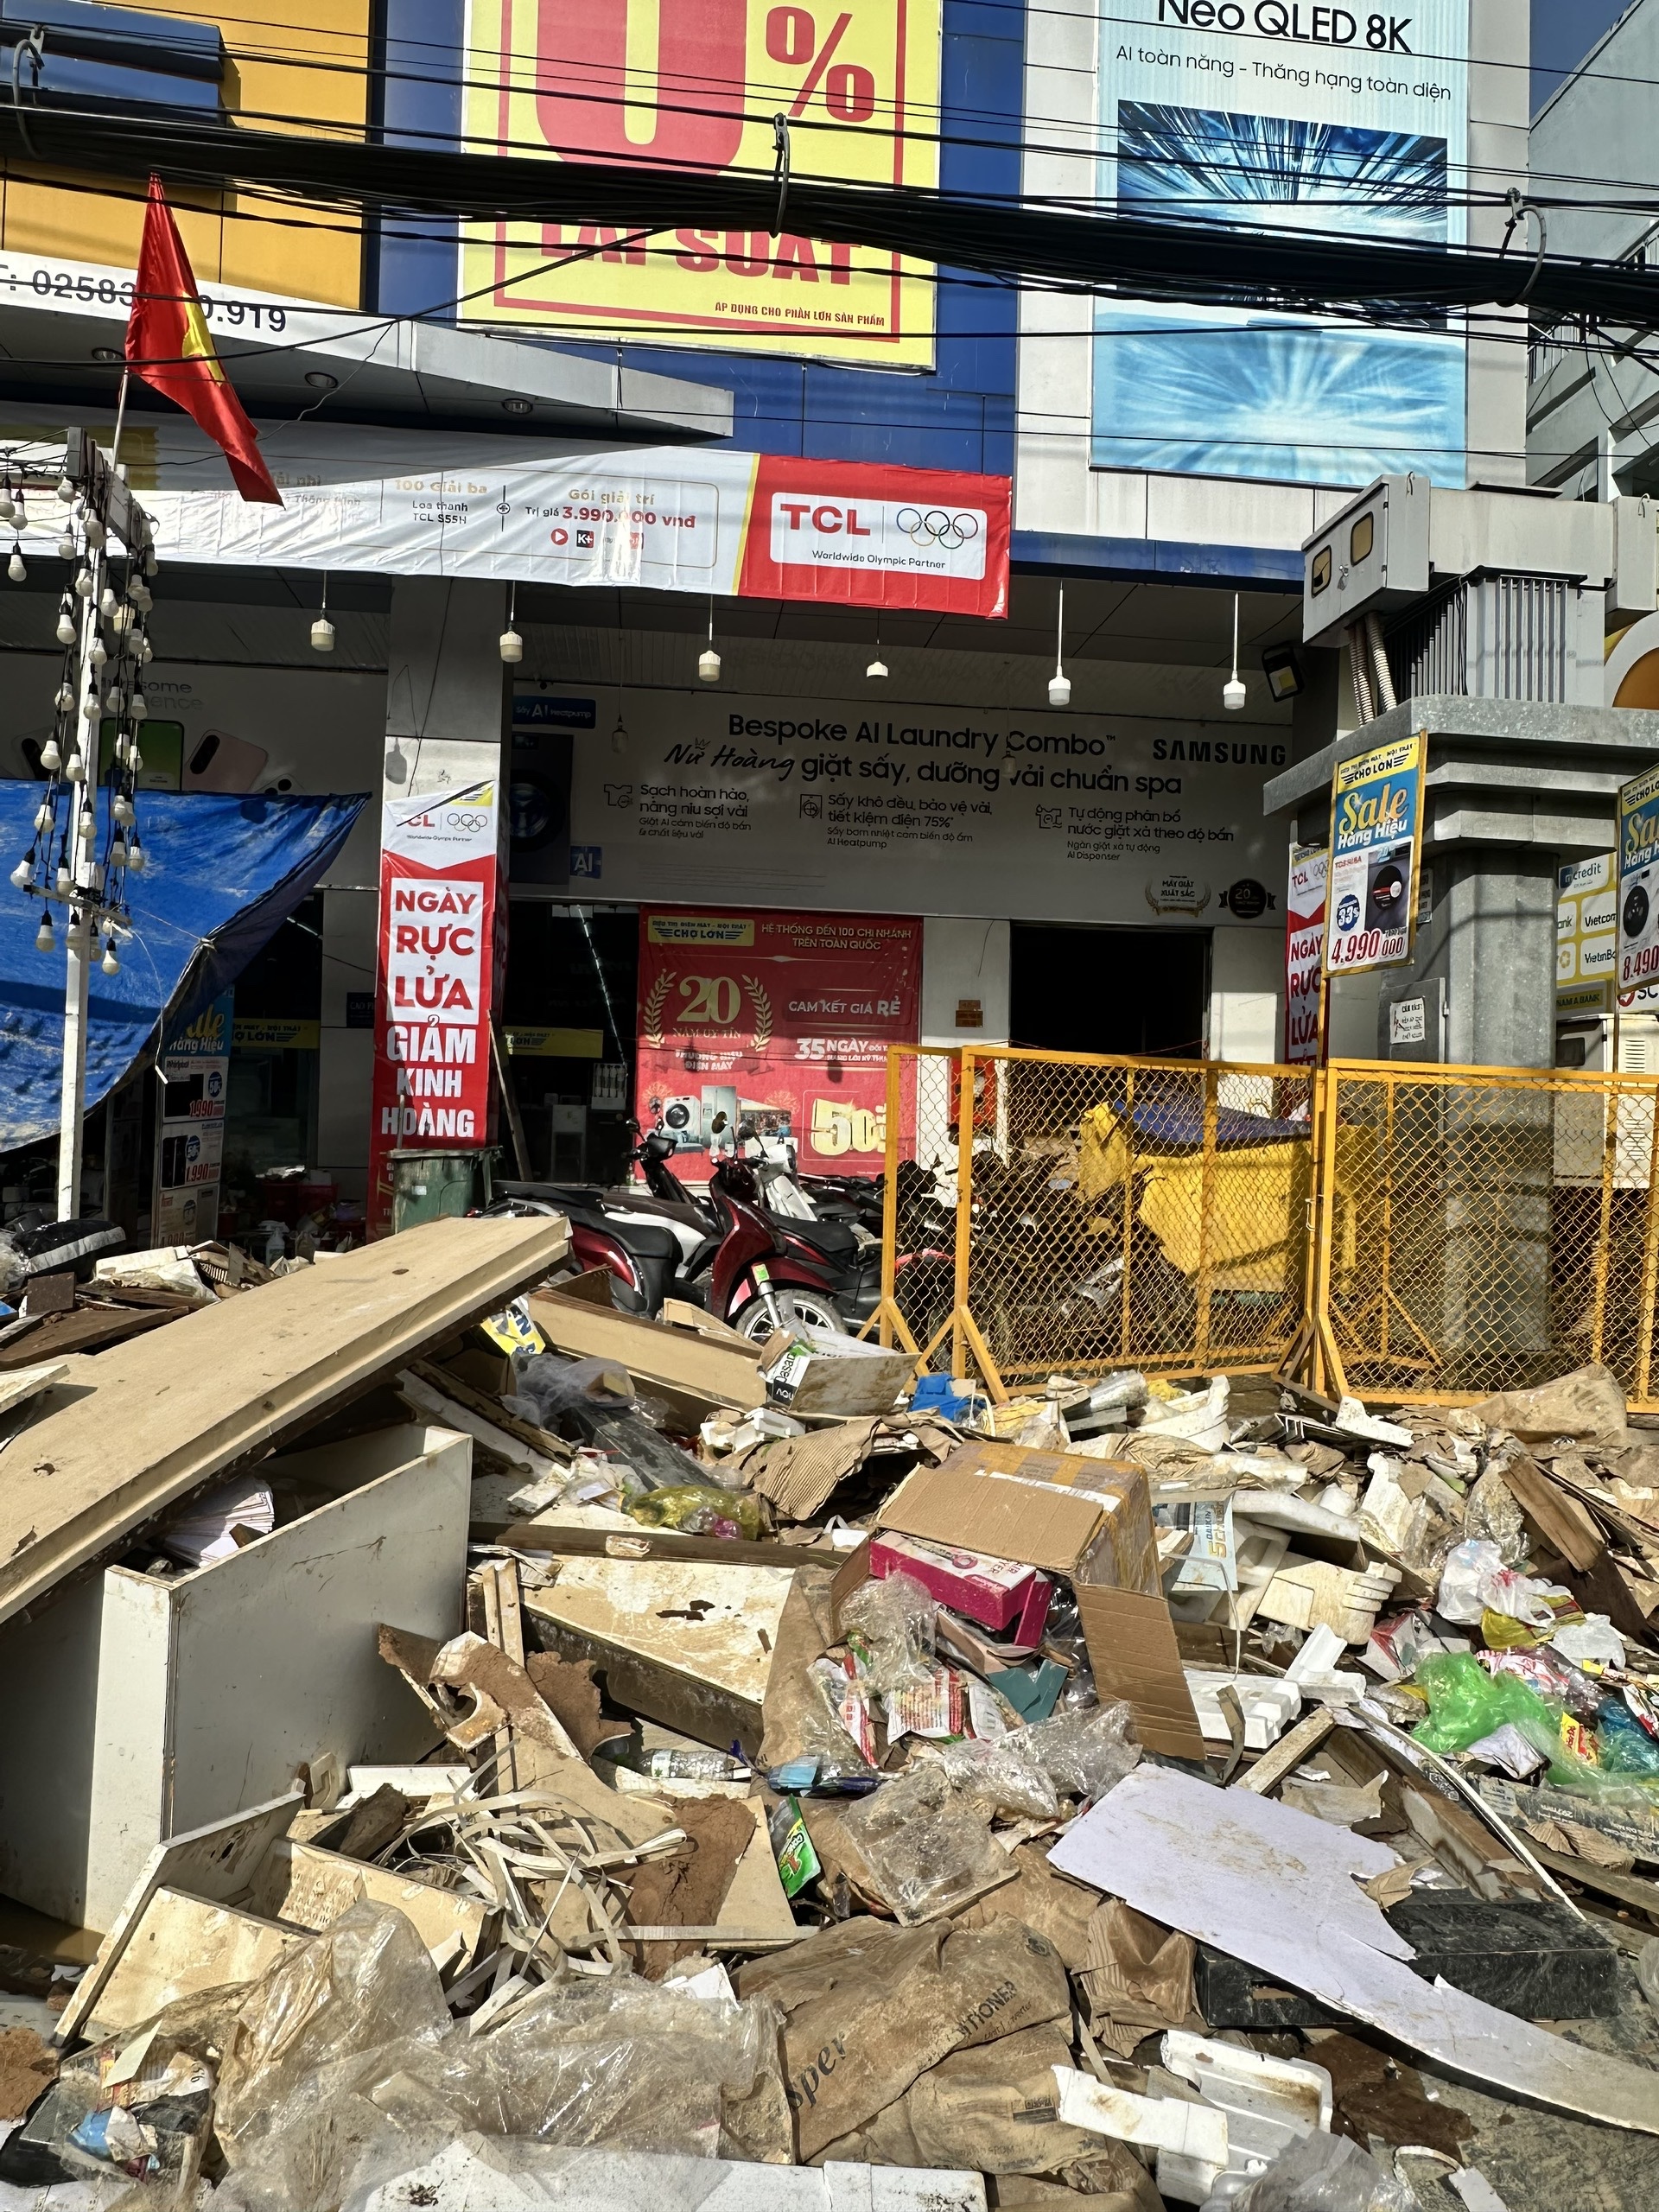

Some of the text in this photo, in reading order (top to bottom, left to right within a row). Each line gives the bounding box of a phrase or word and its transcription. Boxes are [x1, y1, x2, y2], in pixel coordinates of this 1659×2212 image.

[1158, 0, 1413, 54] Neo QLED 8K
[1116, 46, 1452, 103] AI toàn năng Thăng hạng toàn diện
[761, 306, 781, 317] CHO
[395, 480, 424, 493] 100
[467, 481, 487, 495] ba
[412, 499, 468, 512] Loa thanh
[413, 513, 467, 525] TCL S55H
[662, 515, 696, 529] vnđ
[780, 503, 871, 537] TCL
[811, 550, 946, 569] Worldwide Olympic Partner
[728, 714, 999, 758] Bespoke AI Laundry
[1152, 738, 1287, 766] SAMSUNG
[710, 744, 796, 781] Hoàng
[801, 753, 852, 783] giặt
[859, 753, 910, 786] sấy,
[917, 760, 1000, 792] dưỡng
[1009, 764, 1044, 788] vải
[1050, 764, 1129, 792] chuẩn
[1135, 775, 1182, 800] spa
[640, 784, 677, 799] Sạch
[680, 785, 716, 799] hoàn
[704, 804, 724, 819] sợi
[828, 792, 855, 810] Sấy
[857, 795, 884, 809] khô
[950, 800, 968, 817] vệ
[1068, 806, 1085, 822] Tự
[1087, 808, 1122, 823] động
[1125, 809, 1160, 824] phân
[1338, 781, 1410, 836] Sale
[828, 808, 921, 829] tiết kiệm điện
[1067, 822, 1234, 843] nước giặt xả theo độ bẩn
[1338, 818, 1408, 850] Hàng Hiệu
[574, 852, 594, 873] AI
[1077, 851, 1121, 861] Dispenser
[1292, 870, 1309, 887] TCL
[395, 886, 479, 915] NGÀY
[777, 922, 814, 935] THỐNG
[838, 927, 855, 937] 100
[856, 928, 874, 938] CHI
[396, 923, 475, 963] RỰC
[820, 937, 848, 950] TOÀN
[849, 938, 881, 950] QUỐC
[1290, 931, 1324, 963] NGÀY
[394, 965, 474, 1011] LỬA
[677, 975, 741, 1025] 20
[849, 1002, 874, 1014] GIÁ
[876, 995, 901, 1018] RẺ
[386, 1014, 476, 1065] GIẢM
[793, 1038, 826, 1061] 35
[826, 1037, 869, 1053] NGÀY
[397, 1069, 462, 1099] KINH
[381, 1099, 475, 1139] HOÀNG
